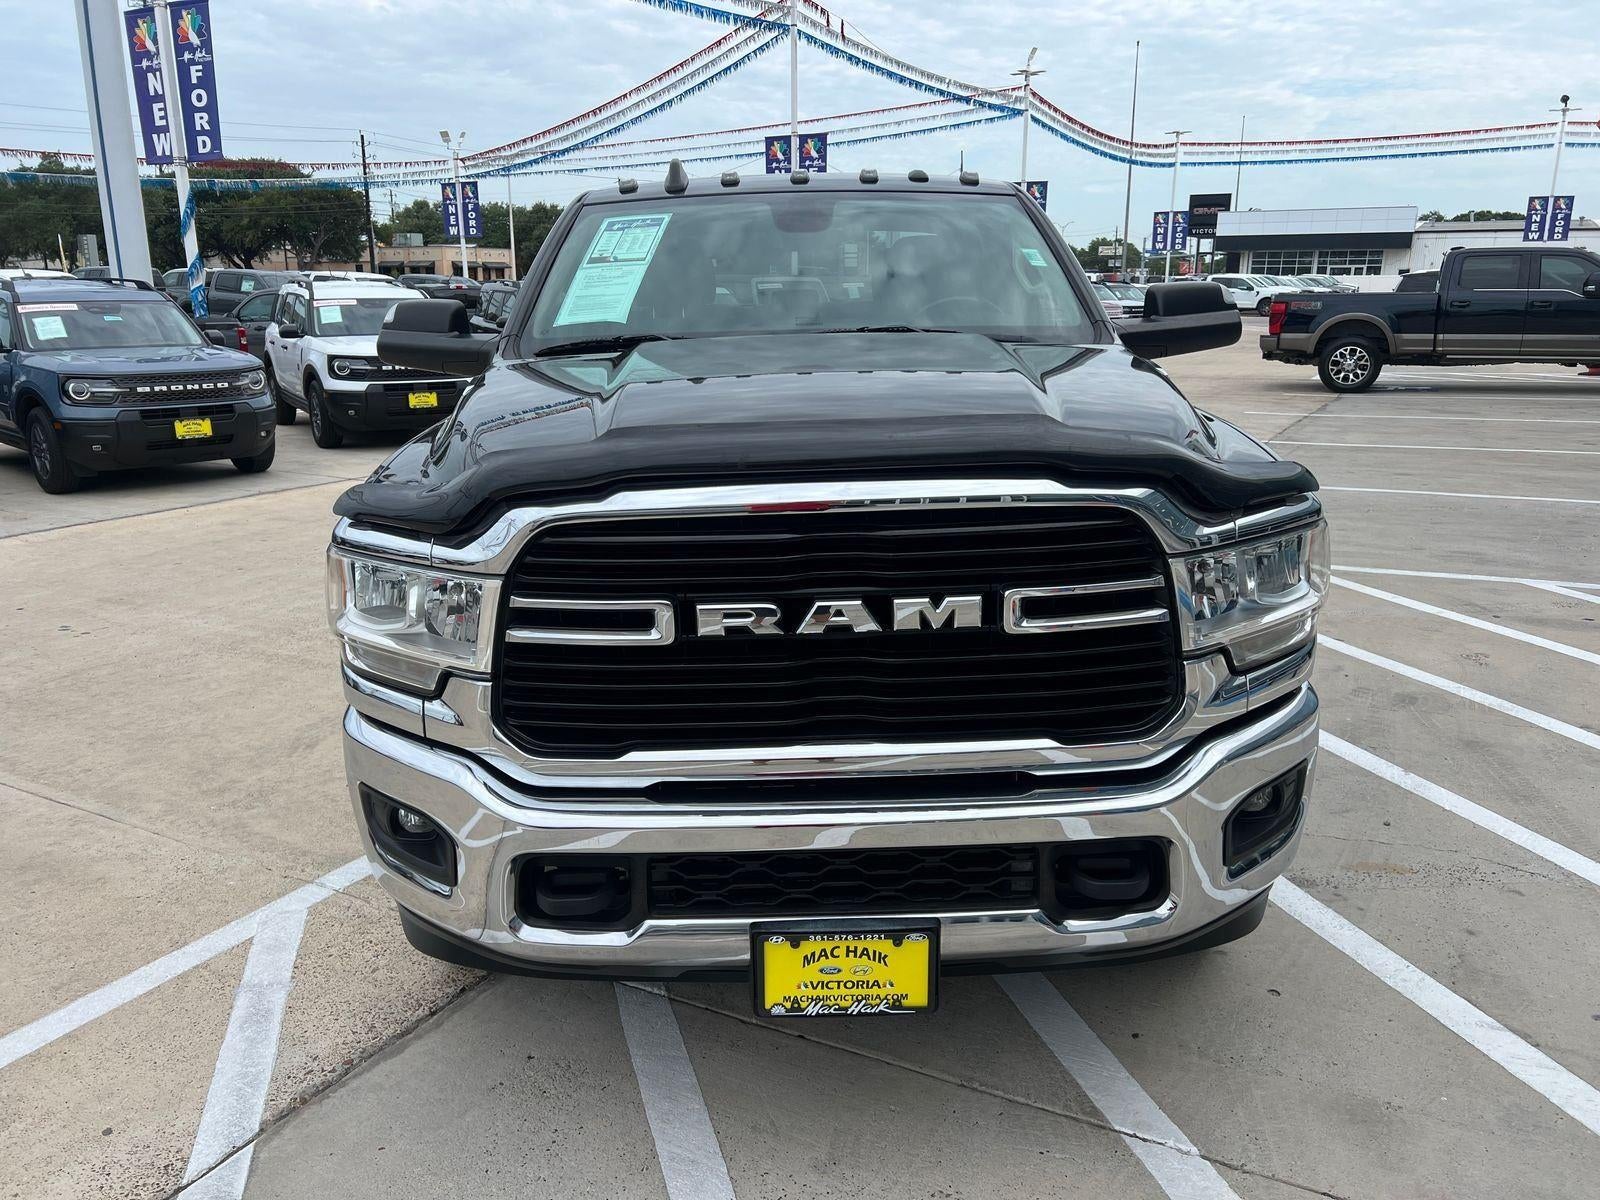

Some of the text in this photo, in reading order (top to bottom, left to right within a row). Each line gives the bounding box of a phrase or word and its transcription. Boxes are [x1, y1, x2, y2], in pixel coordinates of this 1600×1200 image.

[147, 71, 170, 157] NEW
[189, 64, 212, 154] FORD
[448, 204, 458, 236] NEW
[468, 203, 477, 235] FORD
[1528, 214, 1541, 240] NEW
[1553, 213, 1565, 240] FORD
[1155, 227, 1164, 250] NEW
[1175, 226, 1183, 250] FORD
[136, 382, 229, 393] BRONCO
[696, 595, 983, 637] RAM
[808, 934, 885, 942] 361-576-1221
[802, 945, 888, 968] MAC HAIK
[821, 967, 840, 975] Ford
[808, 980, 882, 991] VICTORIA
[804, 999, 895, 1016] Mac Haik
